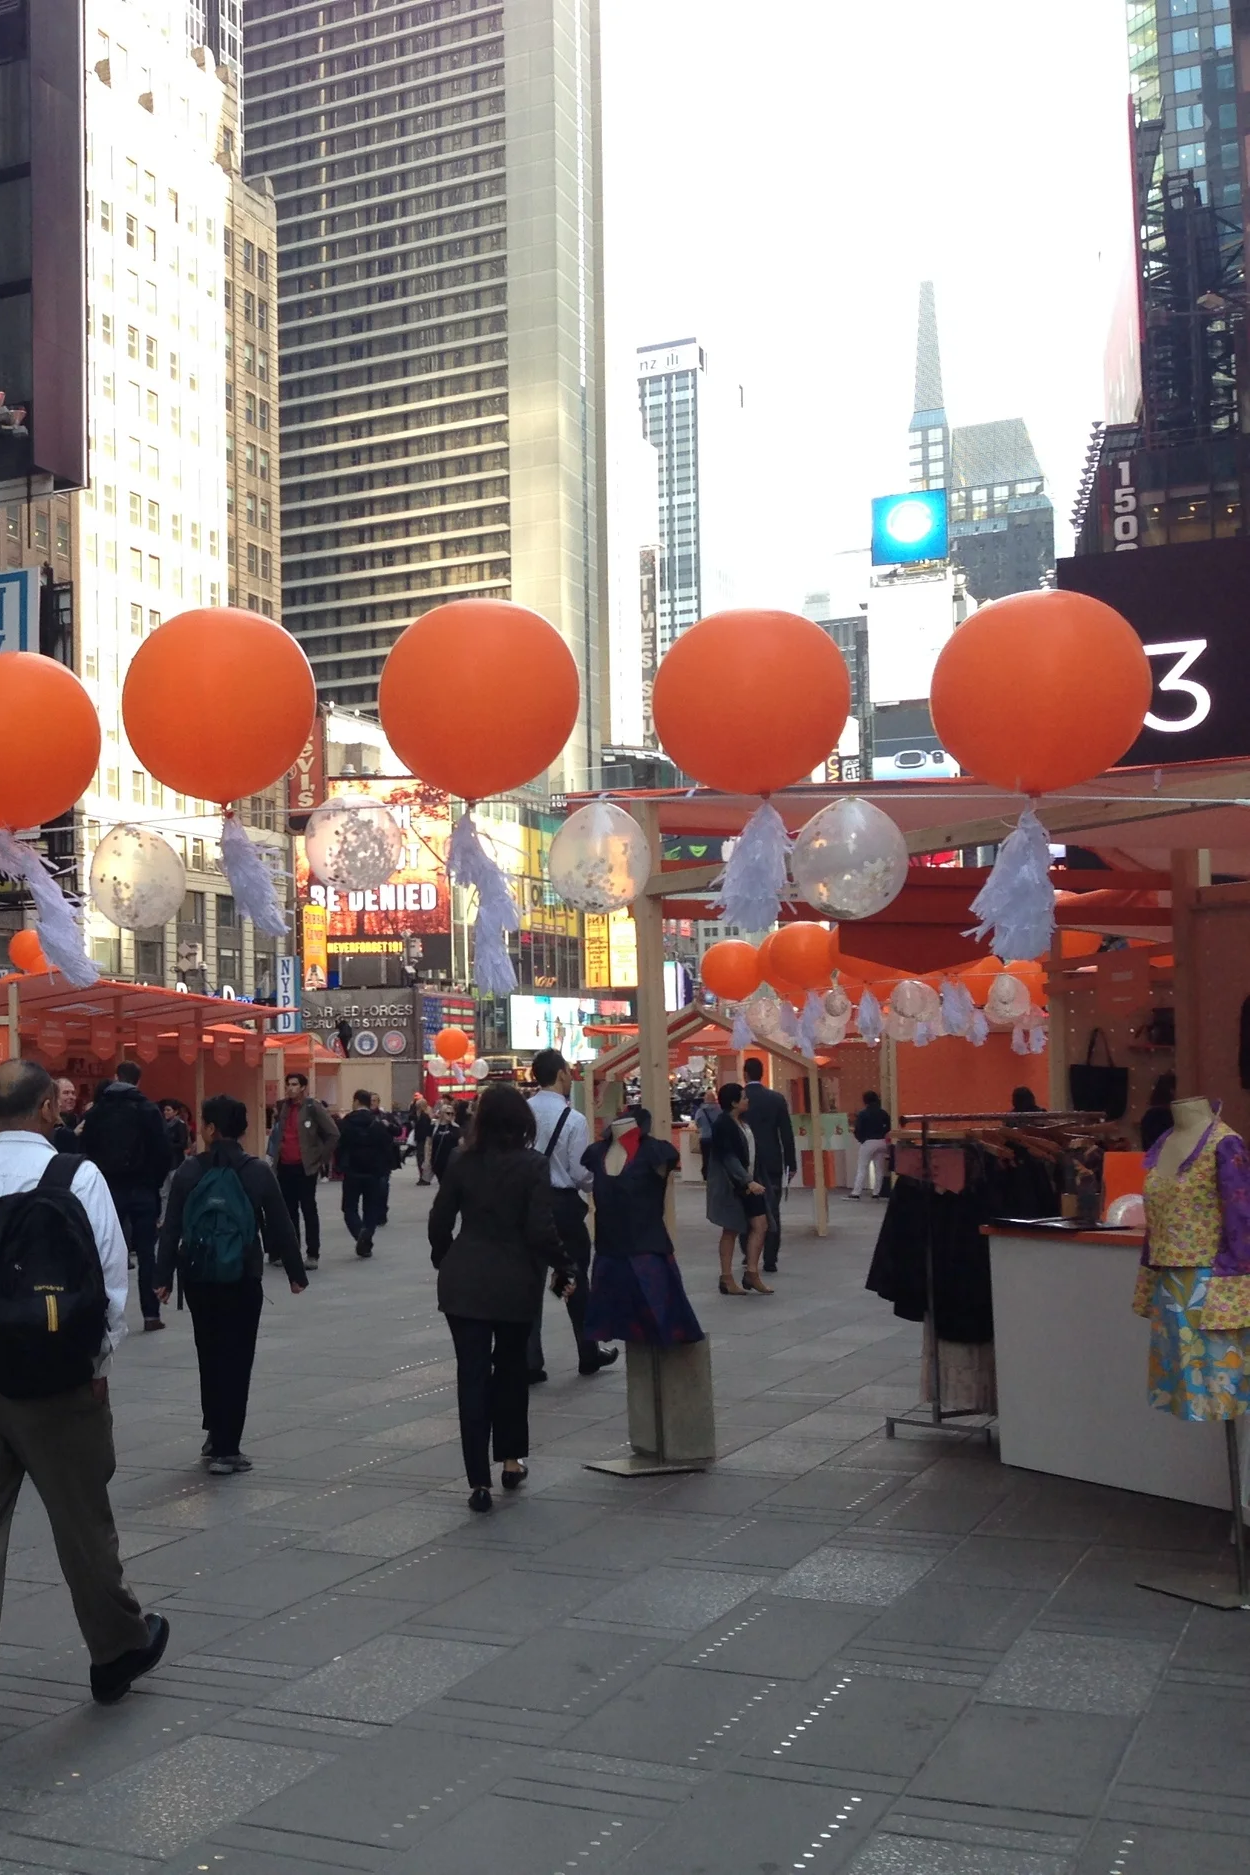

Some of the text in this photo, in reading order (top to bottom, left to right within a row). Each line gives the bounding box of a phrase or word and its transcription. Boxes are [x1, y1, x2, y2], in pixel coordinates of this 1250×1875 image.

[1114, 461, 1138, 551] 150
[1143, 638, 1211, 733] 3
[310, 883, 437, 911] BE DENIED
[281, 958, 291, 1030] NYPD
[316, 1006, 359, 1018] ARED
[362, 1004, 413, 1017] FORCES
[362, 1017, 407, 1028] STATION
